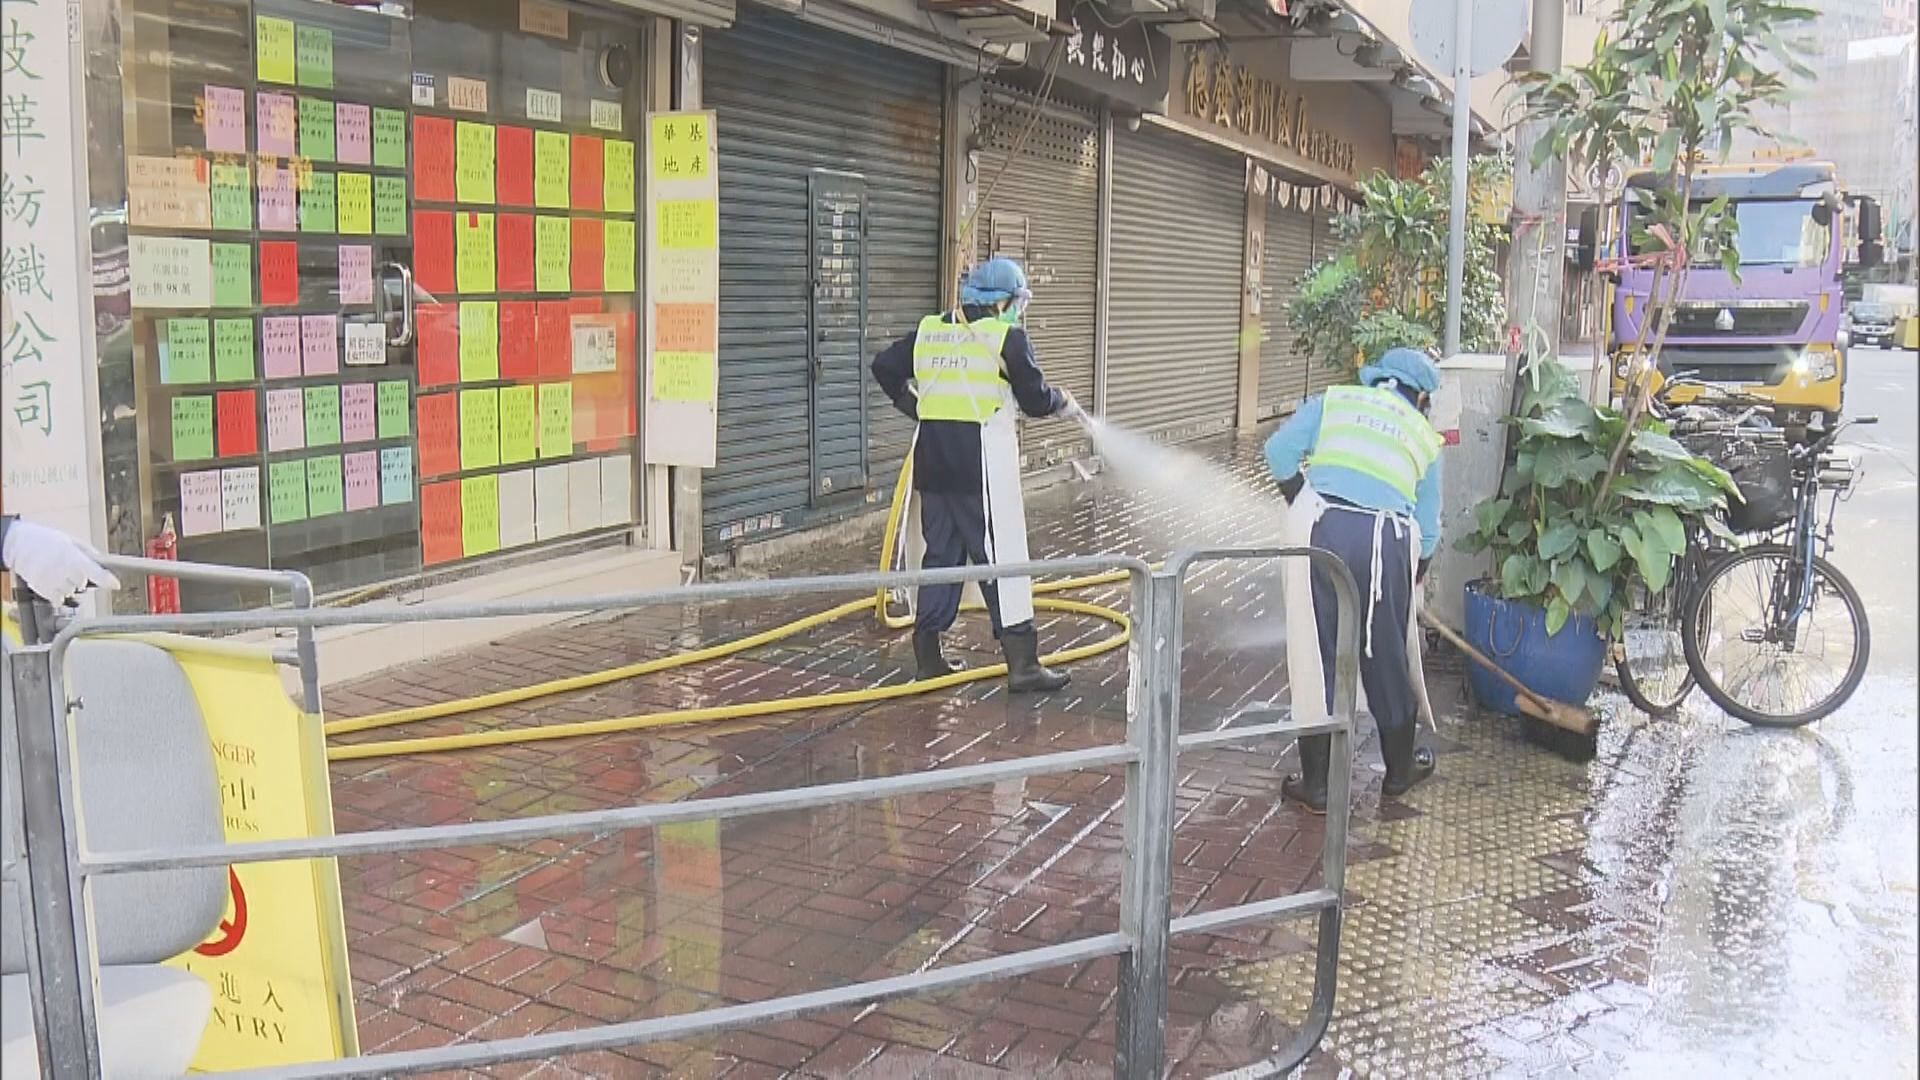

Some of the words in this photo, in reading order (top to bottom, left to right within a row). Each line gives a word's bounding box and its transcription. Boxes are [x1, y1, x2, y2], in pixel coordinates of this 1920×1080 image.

[212, 741, 256, 767] NGER
[226, 816, 260, 832] RESS
[213, 1007, 287, 1044] NTRY
